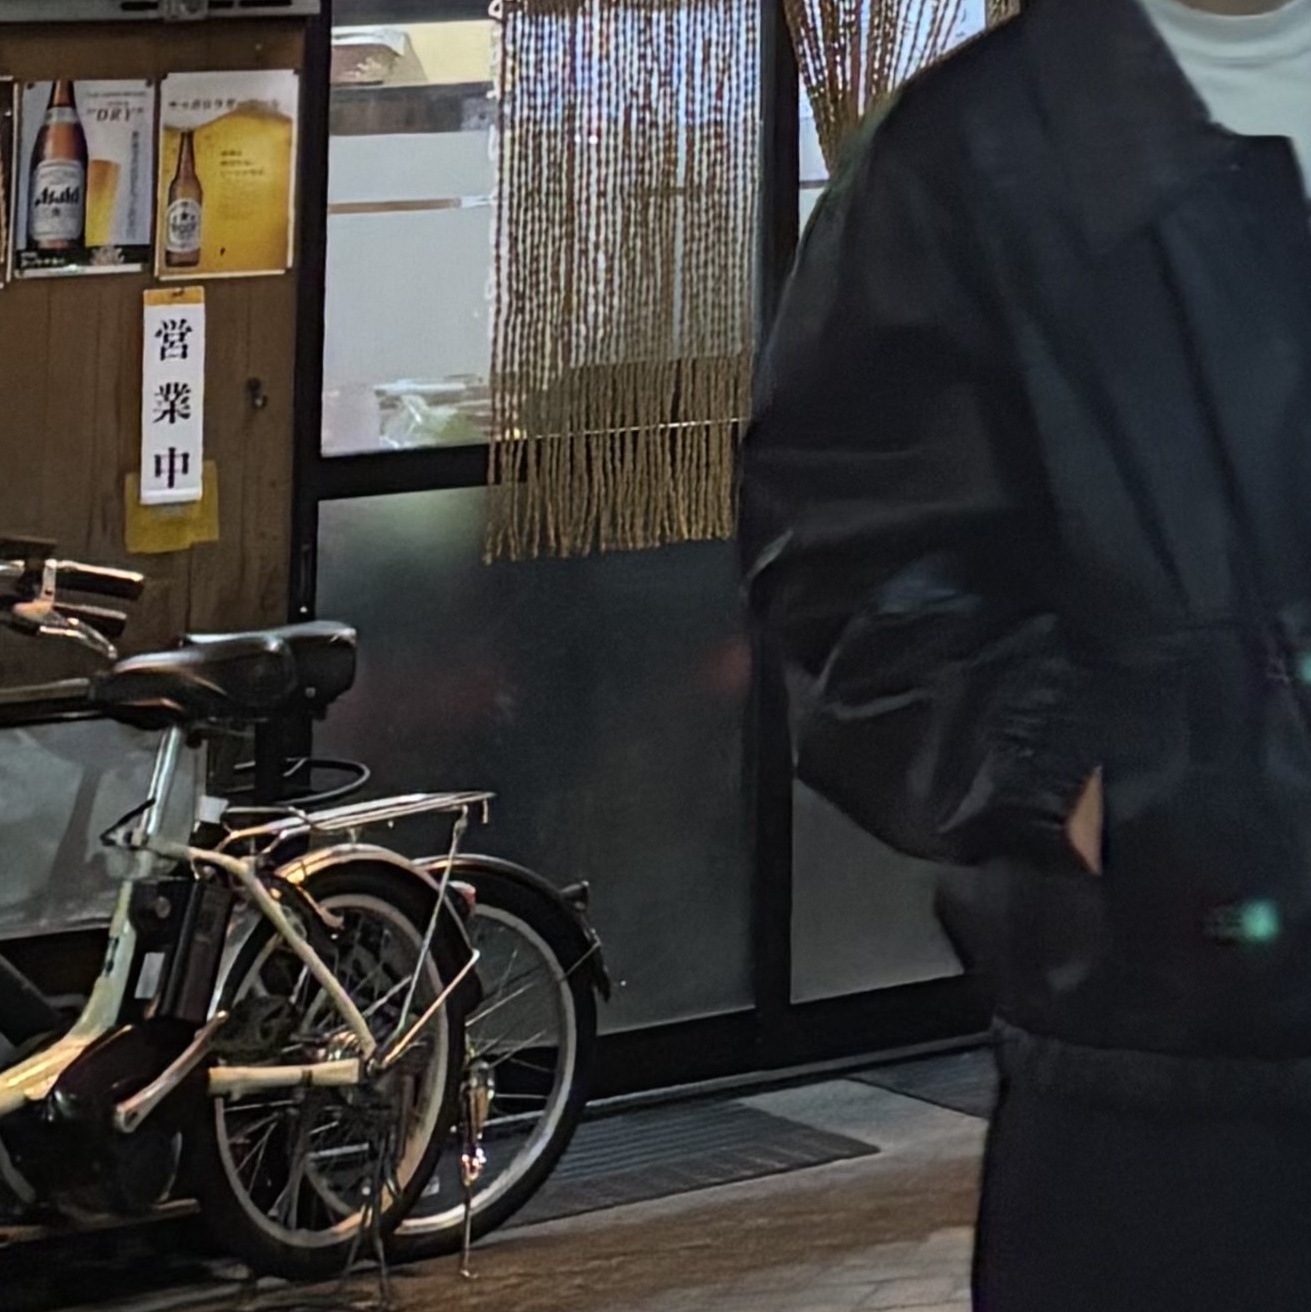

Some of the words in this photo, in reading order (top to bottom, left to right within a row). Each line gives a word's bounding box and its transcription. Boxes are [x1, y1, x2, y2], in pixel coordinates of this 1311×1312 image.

[35, 186, 80, 207] Asahi
[153, 318, 193, 488] 営業中
